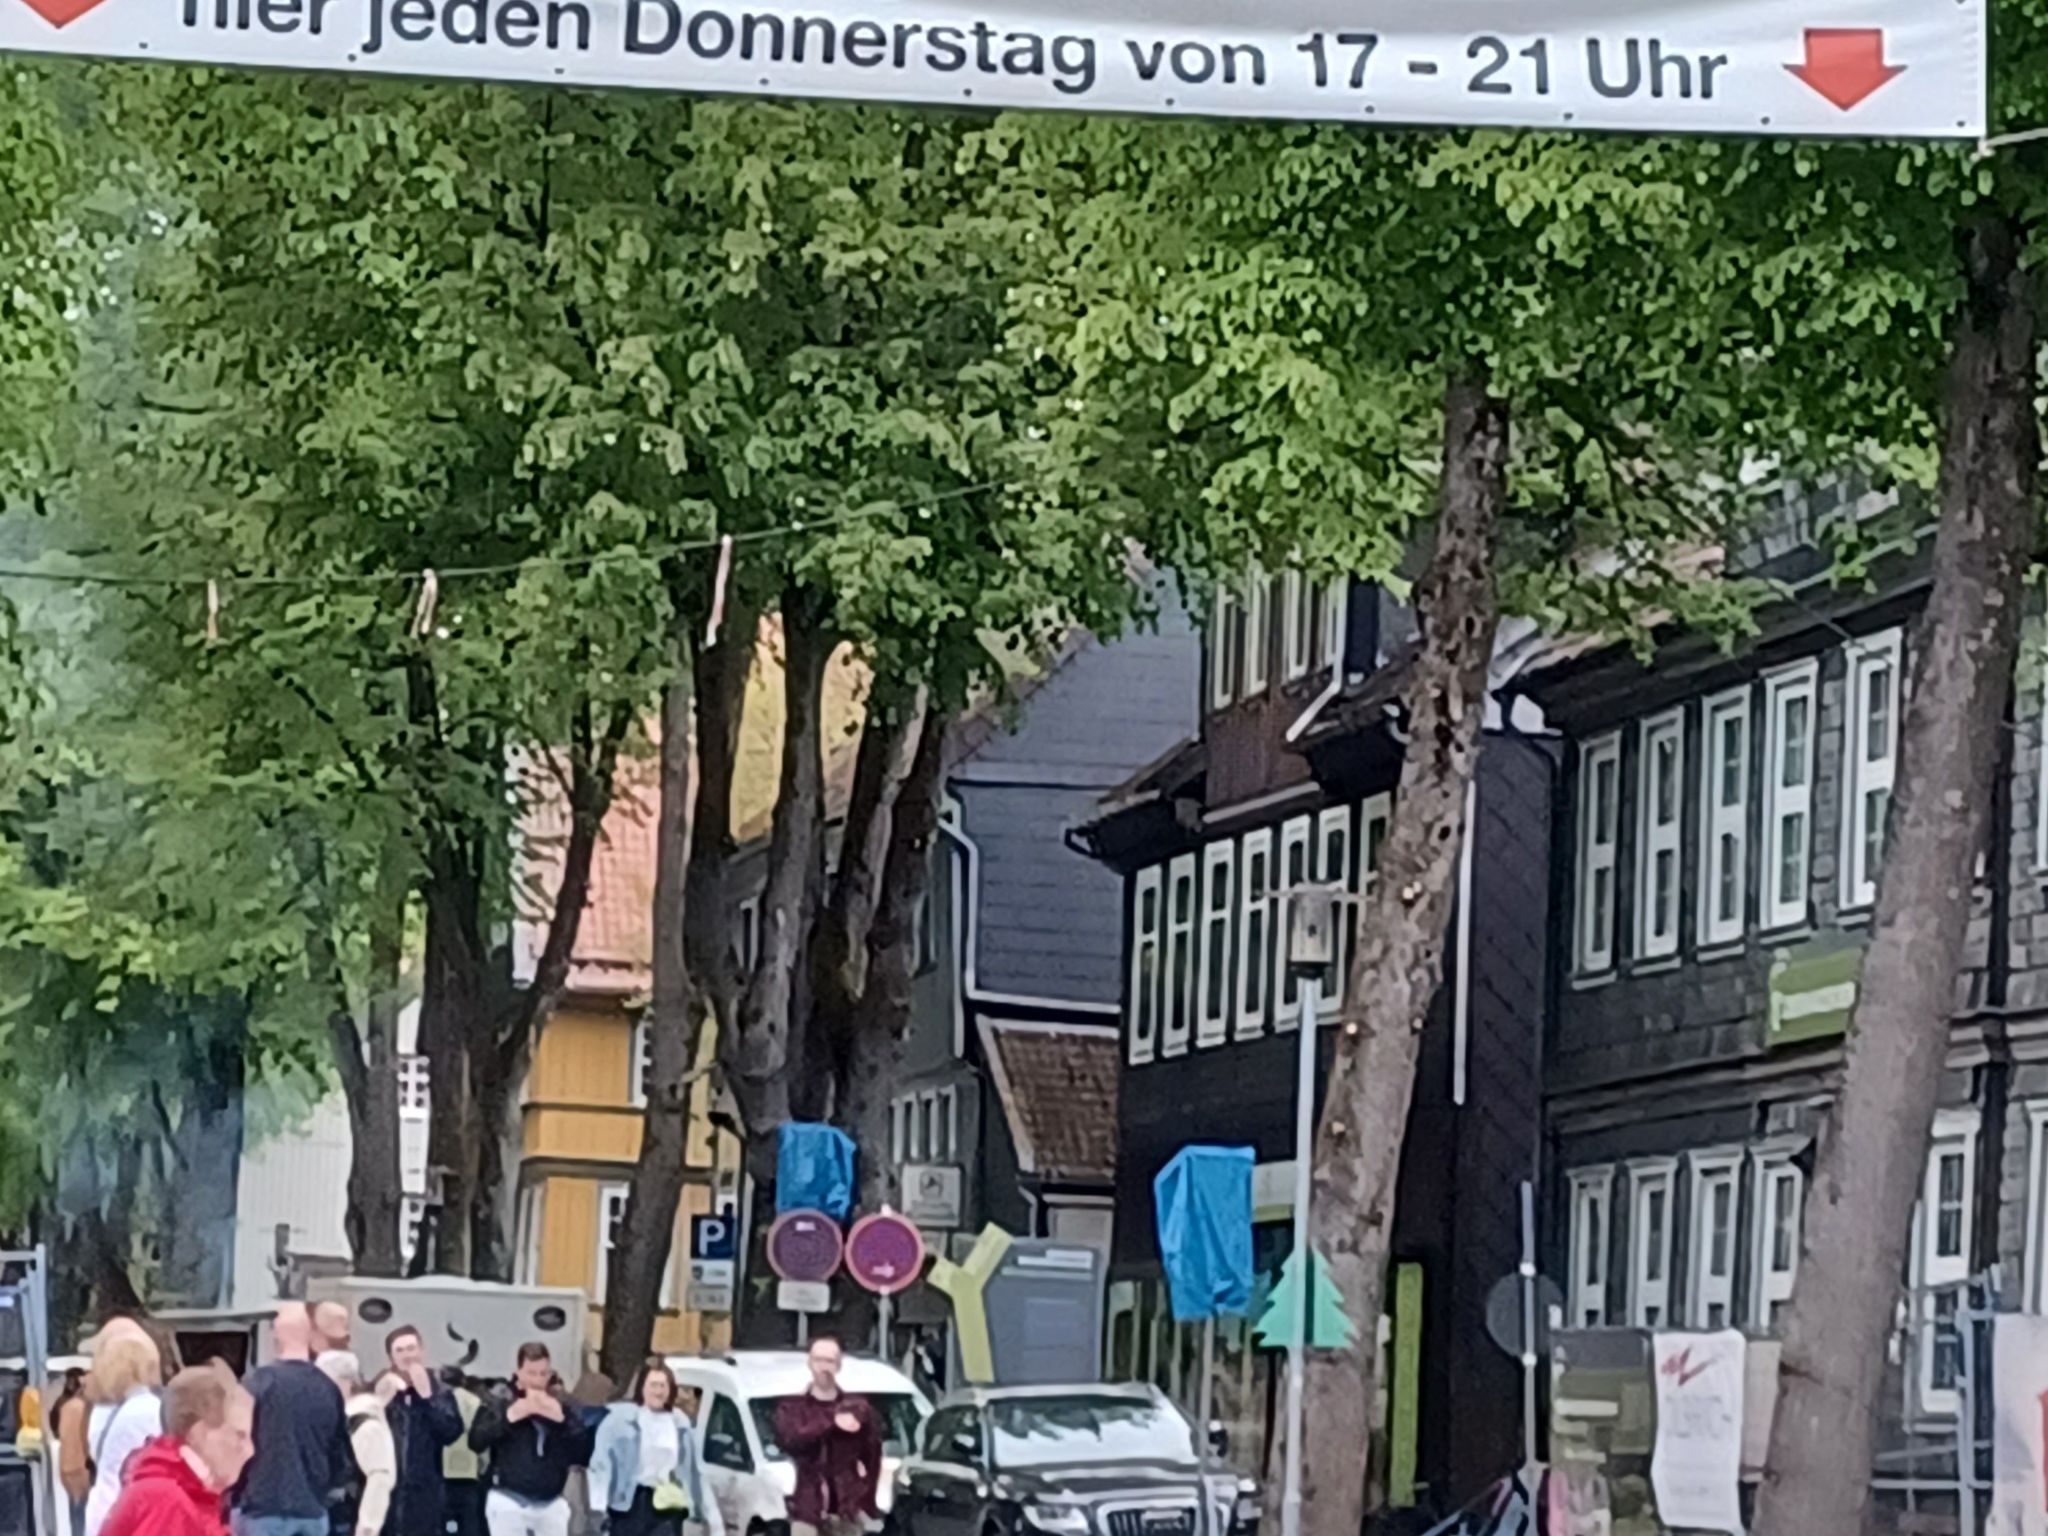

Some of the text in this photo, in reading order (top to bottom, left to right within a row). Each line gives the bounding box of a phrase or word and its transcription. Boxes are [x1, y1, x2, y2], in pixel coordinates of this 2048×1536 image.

[361, 0, 591, 54] jeden
[624, 0, 1097, 95] Donnerstag
[1125, 41, 1266, 86] von
[1297, 32, 1379, 89] 17
[1408, 61, 1438, 75] -
[1467, 36, 1549, 95] 21
[1586, 38, 1728, 100] Uhr
[699, 1219, 725, 1255] P
